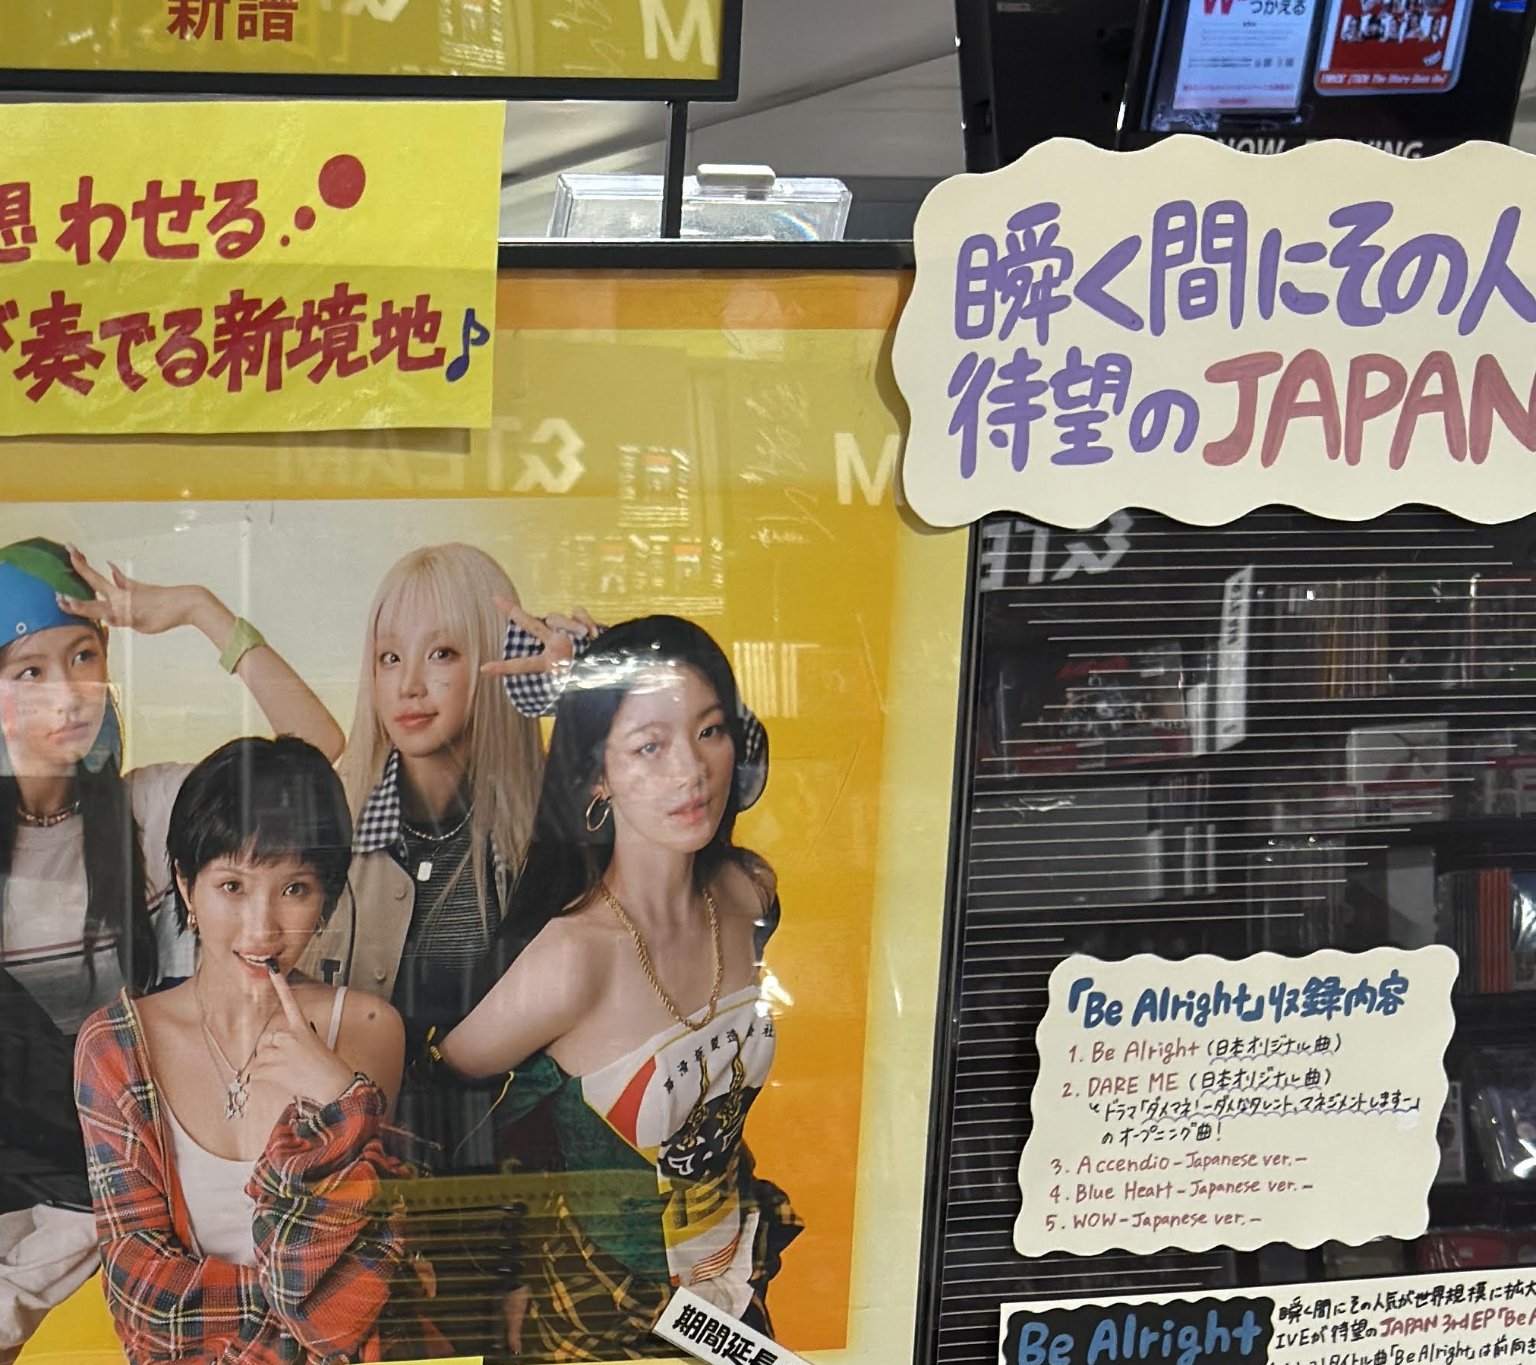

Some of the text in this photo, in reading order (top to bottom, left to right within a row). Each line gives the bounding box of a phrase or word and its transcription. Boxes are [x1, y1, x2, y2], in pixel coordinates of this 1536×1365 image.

[1069, 1049, 1084, 1063] 1.
[1091, 1043, 1115, 1063] Be
[1124, 1038, 1200, 1062] Alright
[1062, 1081, 1079, 1098] 2.
[1089, 1076, 1138, 1096] DARE
[1150, 1072, 1179, 1093] ME
[1050, 1159, 1070, 1175] 3.
[1050, 1184, 1069, 1203] 4.
[1076, 1183, 1115, 1202] Blue
[1045, 1214, 1066, 1232] 5.
[1380, 1316, 1438, 1338] JAPAN
